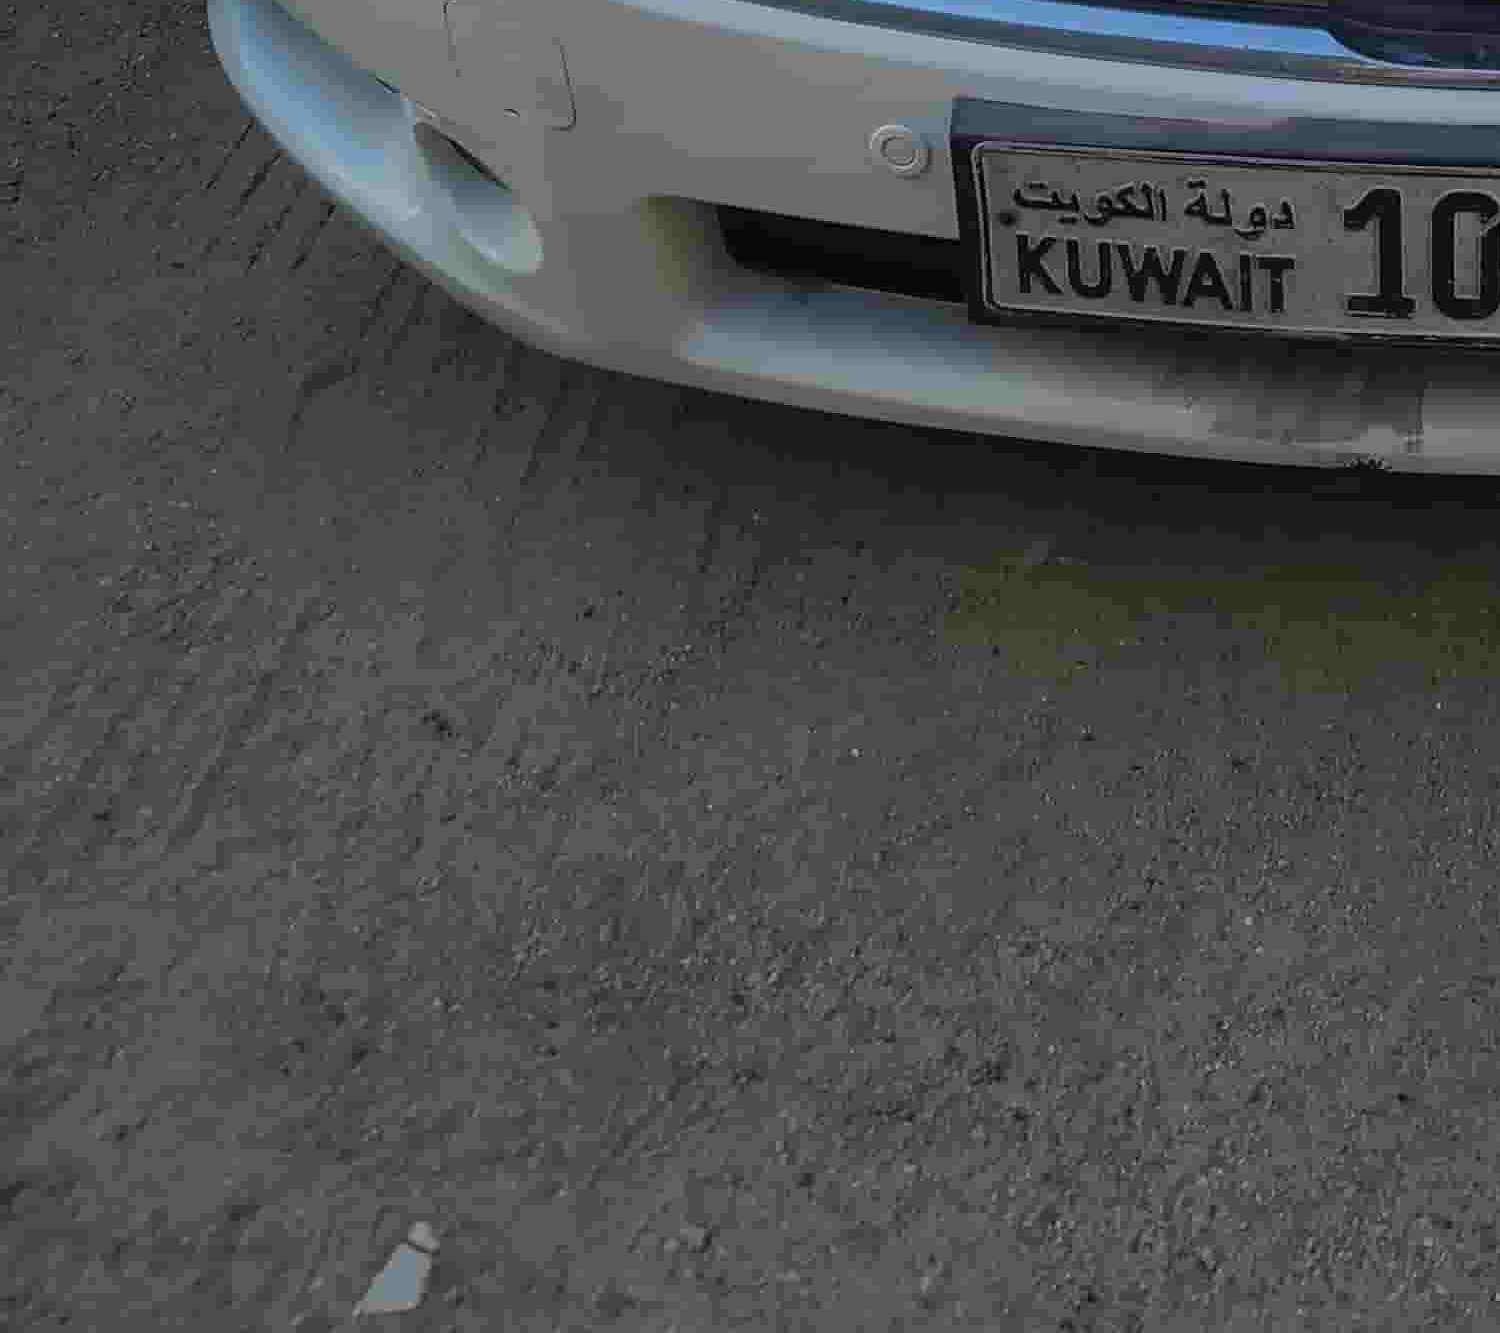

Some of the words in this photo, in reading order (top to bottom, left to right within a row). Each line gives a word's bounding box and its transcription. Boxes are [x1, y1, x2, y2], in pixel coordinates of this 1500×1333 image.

[1012, 181, 1168, 227] الكويت
[1182, 175, 1296, 240] دولة
[1015, 230, 1297, 314] KUWAIT
